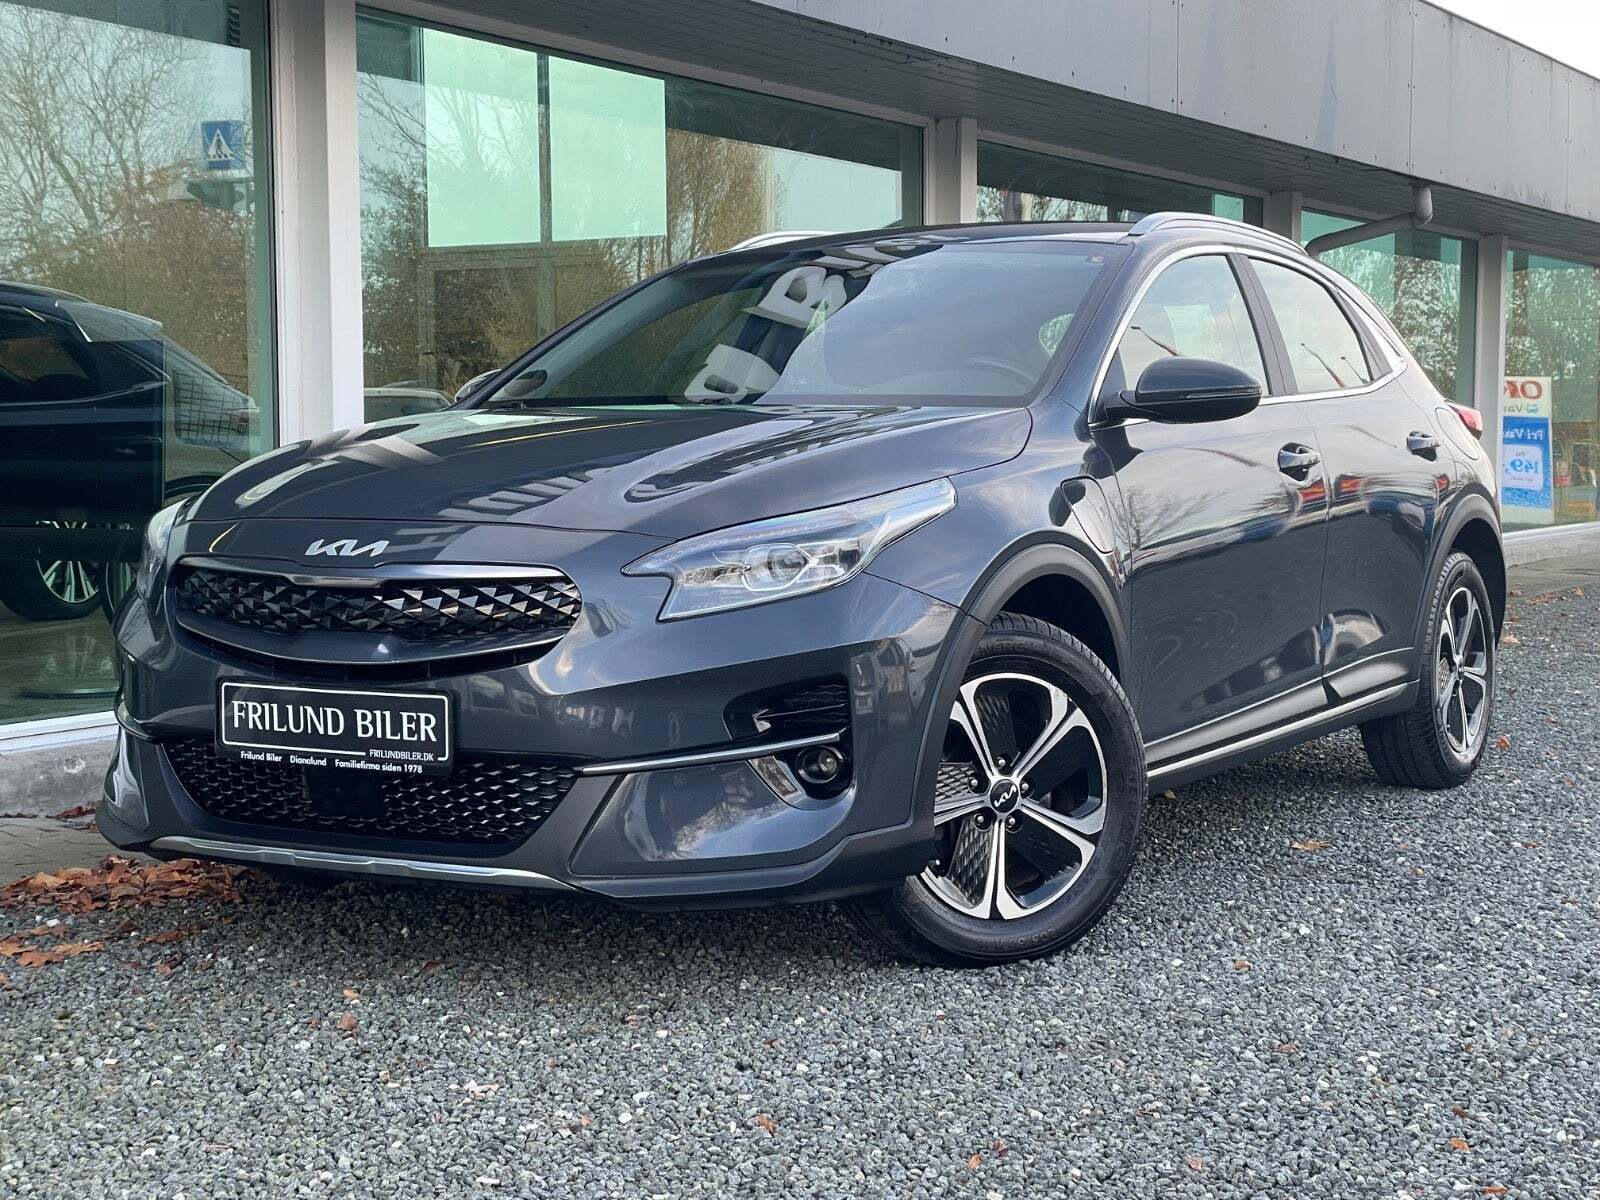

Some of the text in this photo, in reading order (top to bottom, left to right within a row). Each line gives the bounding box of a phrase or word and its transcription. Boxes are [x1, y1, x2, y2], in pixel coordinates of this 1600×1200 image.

[305, 539, 390, 557] KIA
[231, 700, 437, 742] FRILUND BILER
[240, 751, 265, 761] Frilund
[266, 753, 282, 762] Biler
[335, 759, 380, 770] Familiefirma
[382, 762, 402, 772] siden
[404, 764, 423, 774] 1978
[369, 749, 434, 761] FRILUNDBILER.DK
